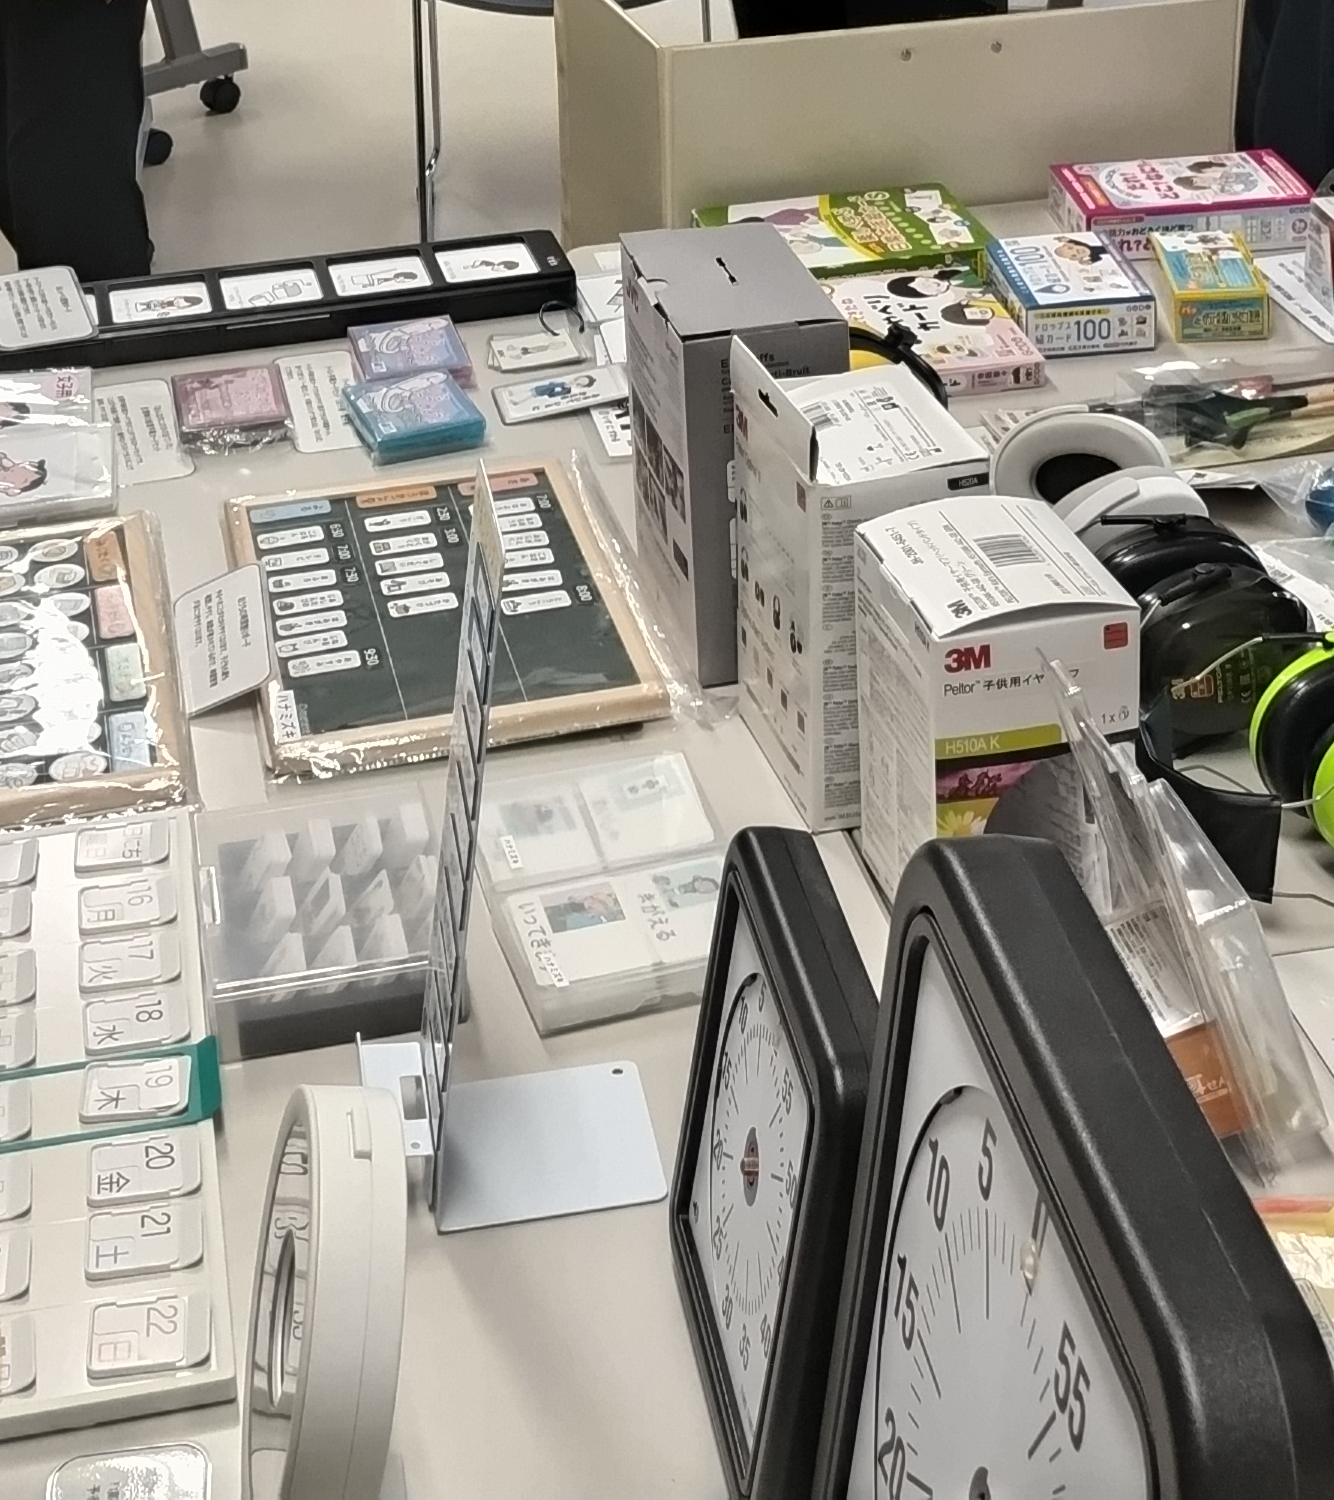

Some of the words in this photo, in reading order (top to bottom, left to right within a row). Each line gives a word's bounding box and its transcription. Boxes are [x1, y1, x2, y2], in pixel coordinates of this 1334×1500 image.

[1009, 246, 1049, 267] 100
[897, 302, 940, 331] カード
[1034, 322, 1071, 333] ドロップス
[1074, 318, 1111, 342] 100
[536, 494, 552, 509] 7:00
[436, 507, 451, 522] 2:30
[329, 523, 345, 539] 6:30
[444, 528, 459, 544] 3:00
[337, 544, 351, 560] 7:00
[344, 566, 359, 583] 7:30
[947, 598, 973, 619] 3M
[364, 648, 380, 666] 9:30
[943, 644, 991, 674] 3M
[982, 668, 1080, 691] 子供用イヤフ
[277, 694, 297, 738] ハナミズキ
[1101, 714, 1107, 725] 1
[945, 737, 987, 756] H510A
[122, 826, 144, 860] 日にち
[503, 839, 519, 865] ハナミズキ
[128, 885, 153, 907] 16
[87, 908, 116, 923] 月
[637, 893, 676, 942] きがえる
[128, 941, 154, 961] 17
[88, 965, 118, 984] 火
[543, 957, 564, 983] ハナミズキ
[758, 979, 766, 1013] 5
[135, 1000, 163, 1023] 18
[738, 996, 749, 1034] 10
[93, 1025, 124, 1045] 水
[144, 1065, 173, 1088] 19
[722, 1051, 732, 1091] 15
[94, 1089, 126, 1111] 木
[781, 1066, 794, 1115] 55
[144, 1142, 175, 1170] 20
[713, 1128, 724, 1171] 20
[977, 1117, 997, 1202] 5
[97, 1172, 130, 1194] 金
[785, 1159, 797, 1209] 50
[926, 1136, 951, 1233] 10
[141, 1212, 172, 1237] 21
[713, 1215, 724, 1260] 25
[95, 1245, 129, 1268] 土
[777, 1255, 785, 1286] 4
[722, 1283, 733, 1331] 30
[894, 1253, 920, 1351] 15
[146, 1304, 178, 1337] 22
[739, 1322, 751, 1371] 35
[760, 1313, 771, 1359] 40
[98, 1340, 132, 1361] 日
[1053, 1320, 1091, 1452] 55
[878, 1406, 907, 1500] 20
